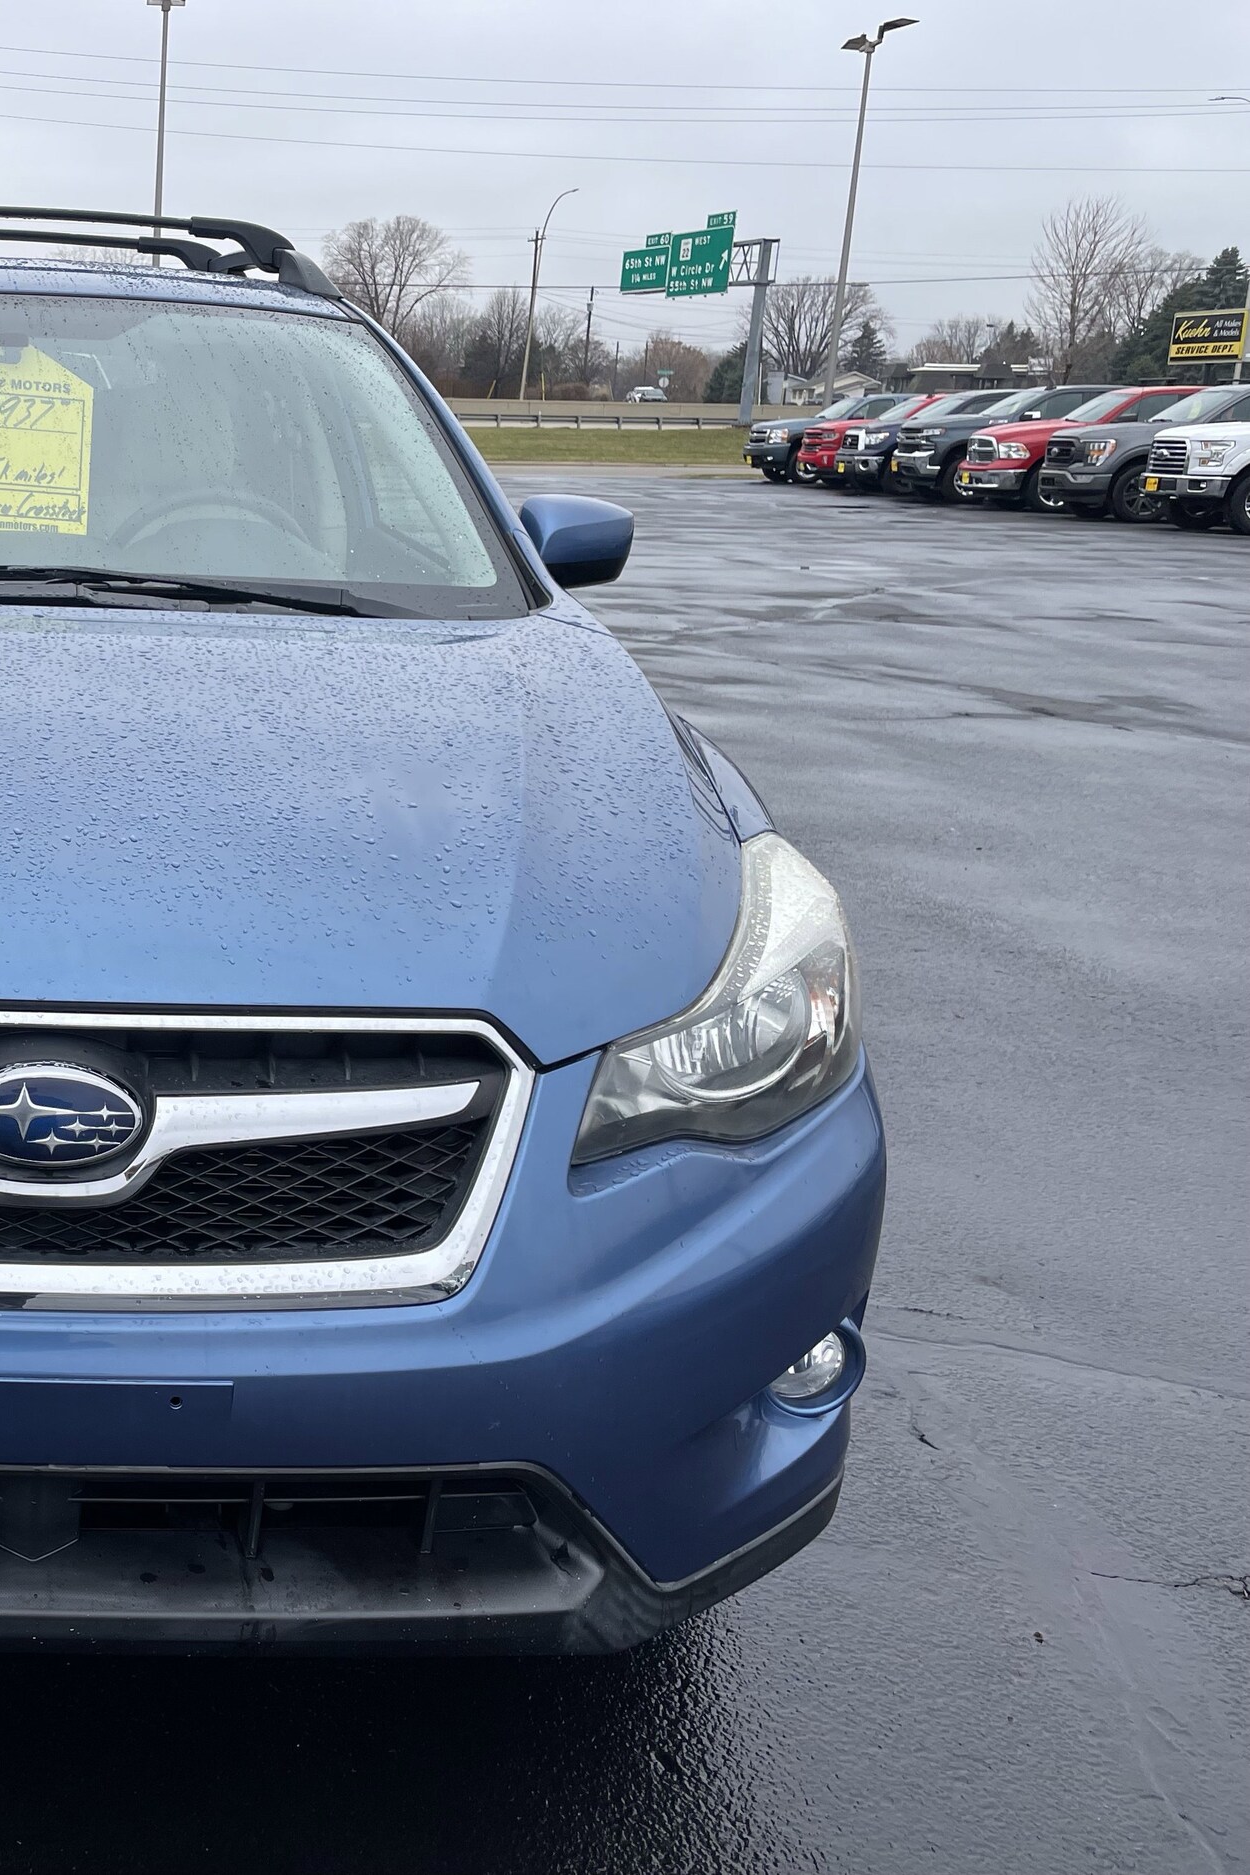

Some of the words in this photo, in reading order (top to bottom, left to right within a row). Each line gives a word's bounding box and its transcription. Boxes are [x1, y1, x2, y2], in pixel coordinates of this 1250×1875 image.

[723, 213, 734, 224] 59
[660, 234, 669, 245] 60
[695, 236, 710, 246] WEST
[682, 247, 690, 258] 22
[625, 258, 642, 270] 65th
[644, 256, 652, 267] St
[654, 255, 666, 266] NW
[671, 266, 677, 277] W
[680, 264, 702, 276] Circle
[705, 262, 715, 274] Dr
[669, 280, 687, 292] 55th
[690, 279, 698, 290] St
[702, 277, 714, 287] NW
[1175, 319, 1211, 341] Kuehn
[1175, 345, 1209, 355] SERVICE
[1211, 344, 1234, 353] DEPT.
[11, 379, 71, 394] MOTORS
